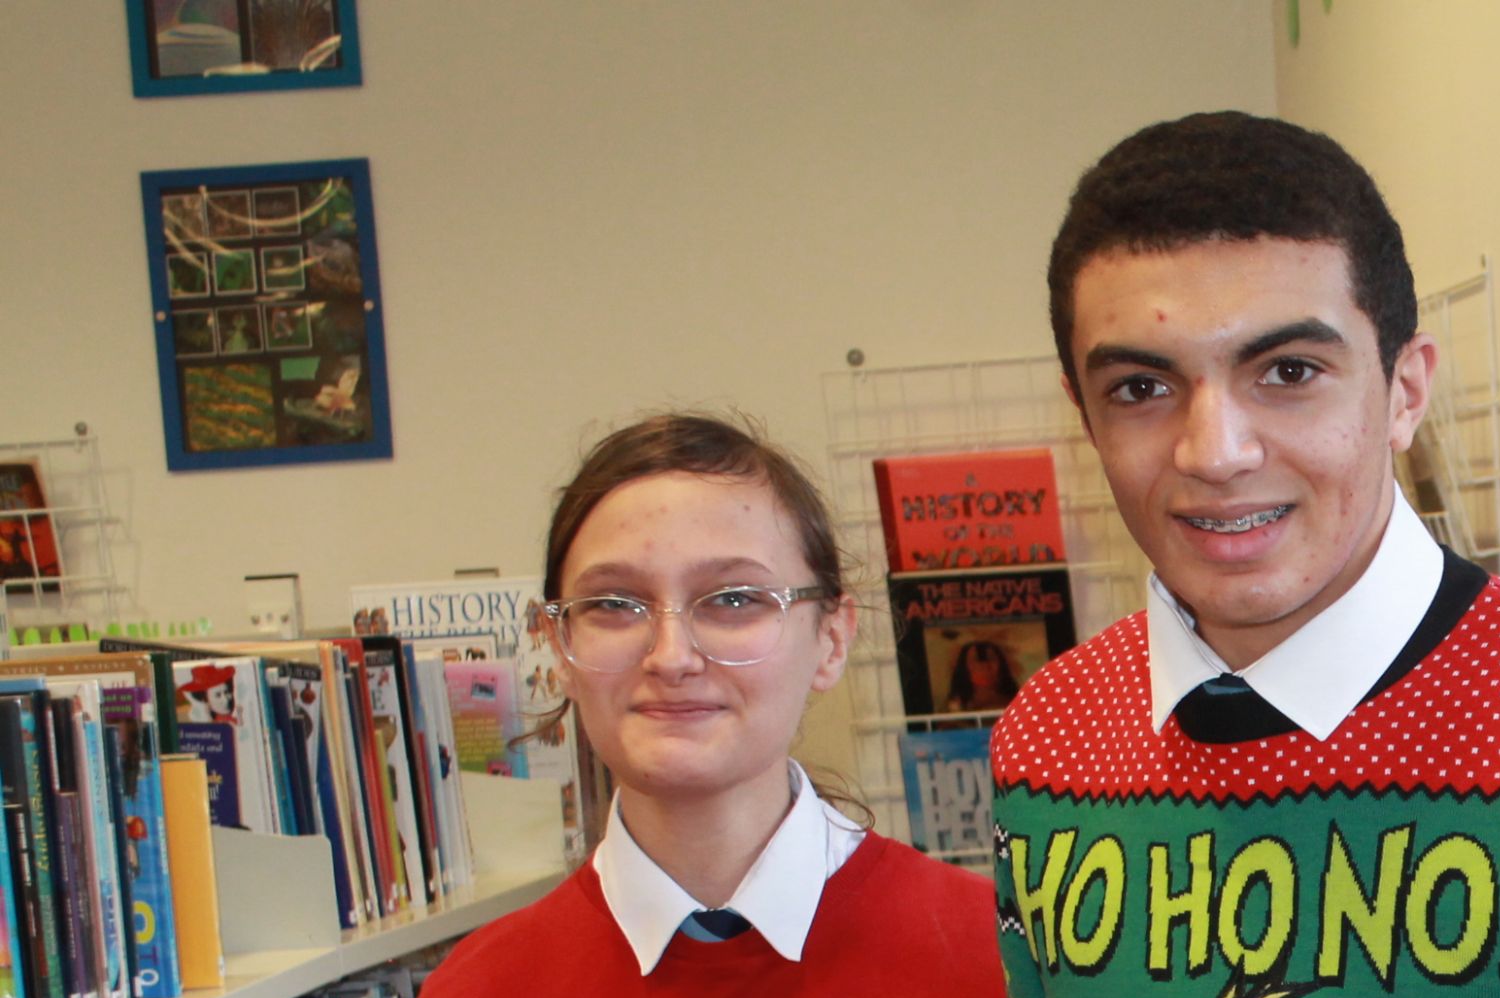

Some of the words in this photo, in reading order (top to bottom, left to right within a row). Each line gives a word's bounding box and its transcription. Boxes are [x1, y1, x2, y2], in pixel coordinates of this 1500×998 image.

[902, 488, 1046, 521] HISTORY
[943, 524, 970, 541] OF
[911, 543, 1056, 569] WORLD
[917, 582, 961, 599] THE
[965, 577, 1042, 596] NATIVE
[392, 590, 521, 627] HISTORY
[906, 592, 1063, 620] AMERICANS
[1009, 827, 1126, 977] HO
[1146, 829, 1298, 981] HO
